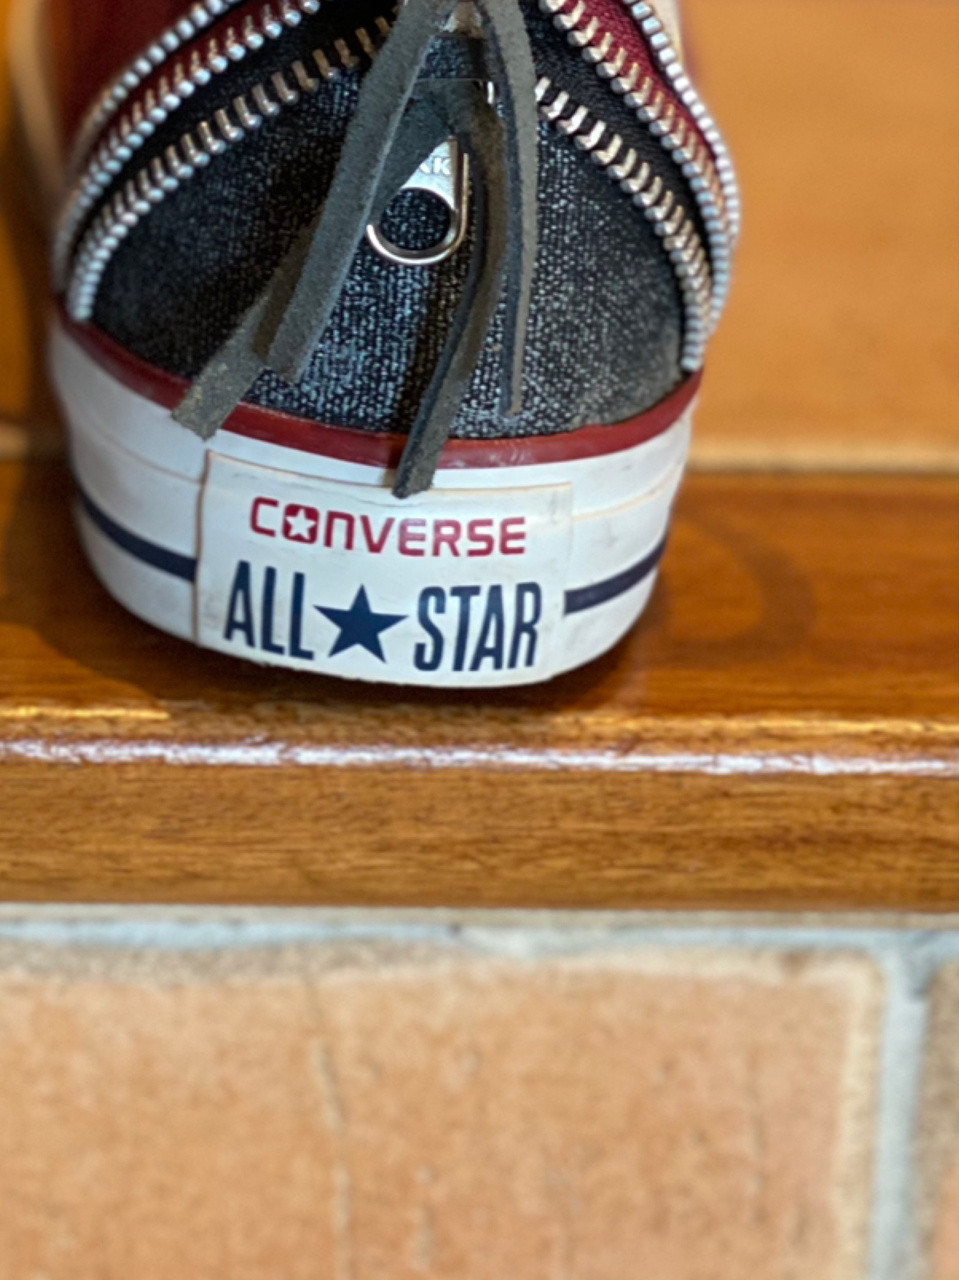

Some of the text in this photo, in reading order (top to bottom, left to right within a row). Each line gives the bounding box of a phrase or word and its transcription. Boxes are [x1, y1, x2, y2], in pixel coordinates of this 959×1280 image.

[250, 496, 527, 558] CONVERSE
[223, 559, 541, 673] ALL STAR
